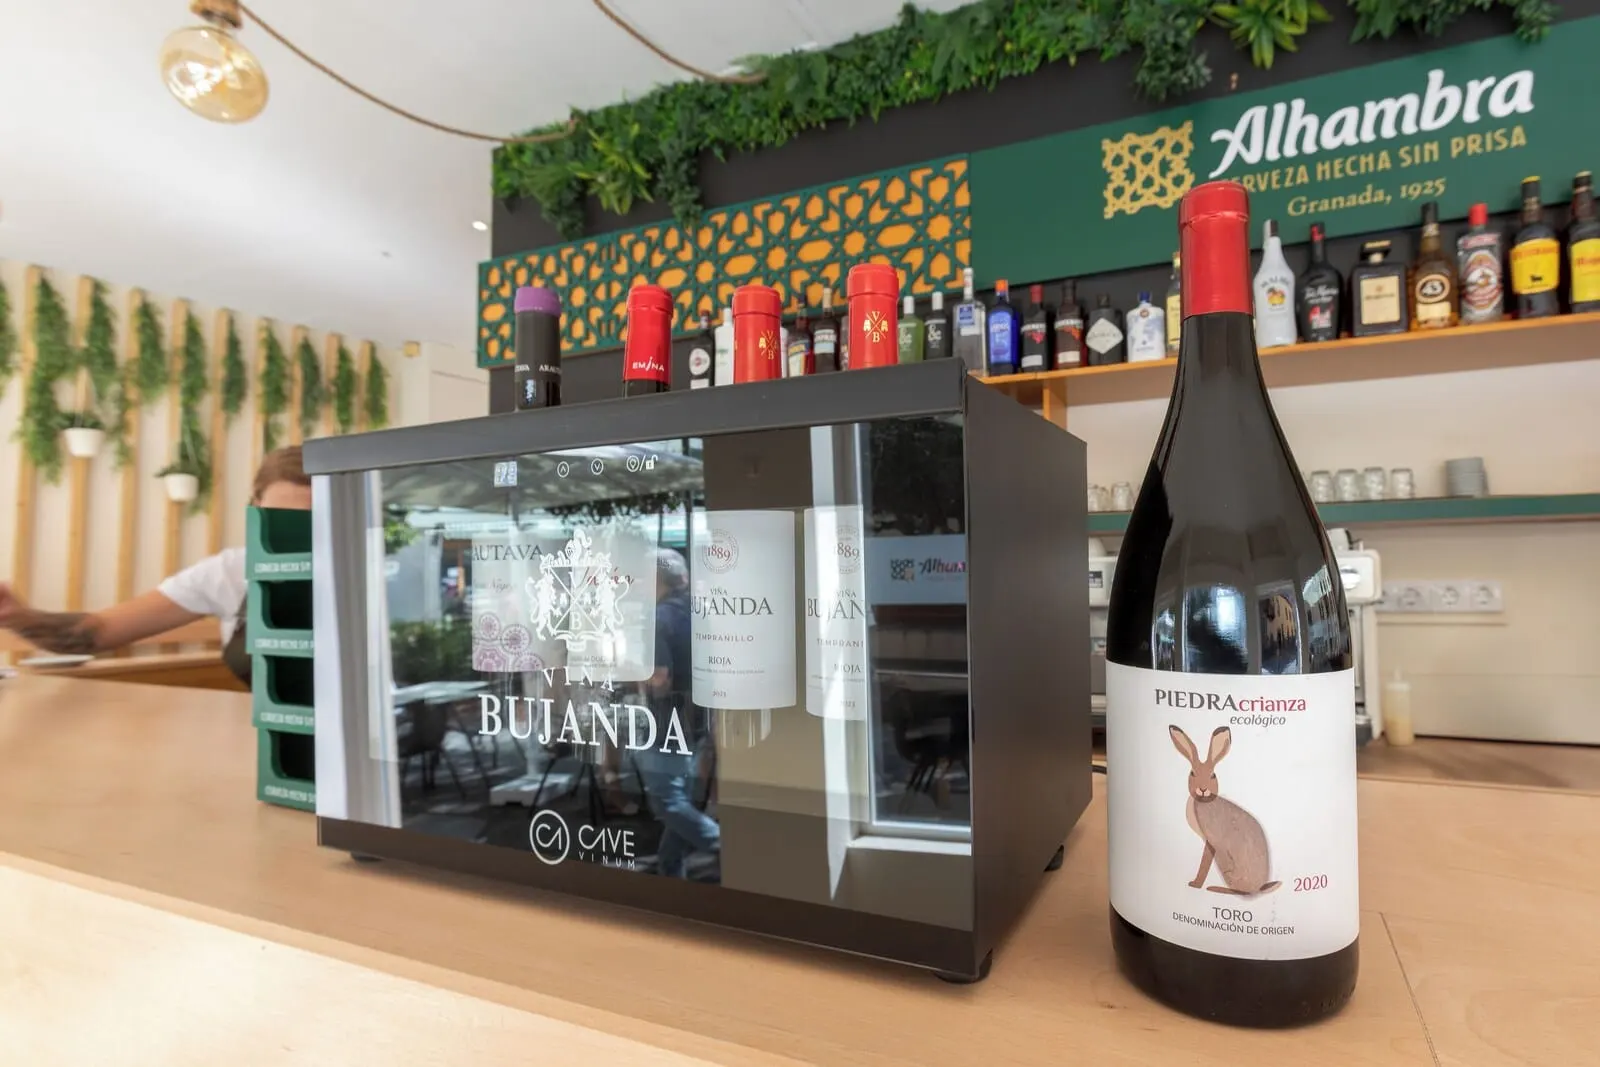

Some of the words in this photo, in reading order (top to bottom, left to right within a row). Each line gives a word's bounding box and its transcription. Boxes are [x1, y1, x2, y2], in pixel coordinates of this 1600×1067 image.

[1209, 68, 1534, 179] Alhambra
[1232, 164, 1310, 193] RVEZA
[1316, 149, 1392, 182] HECHA
[1398, 141, 1440, 167] SIN
[1451, 125, 1527, 158] PRISA
[1287, 184, 1392, 217] Granada,
[1400, 176, 1446, 200] 1925
[706, 543, 731, 562] 1889
[478, 693, 693, 756] BUJANDA
[1229, 713, 1287, 728] ecológico
[578, 824, 635, 857] CAVE
[579, 851, 636, 870] VINUM
[1293, 874, 1329, 892] 2020
[1172, 911, 1244, 934] DENOMINACIÓN
[1246, 926, 1259, 935] DE
[1260, 926, 1295, 936] ORIGEN
[1212, 906, 1254, 923] TORO
